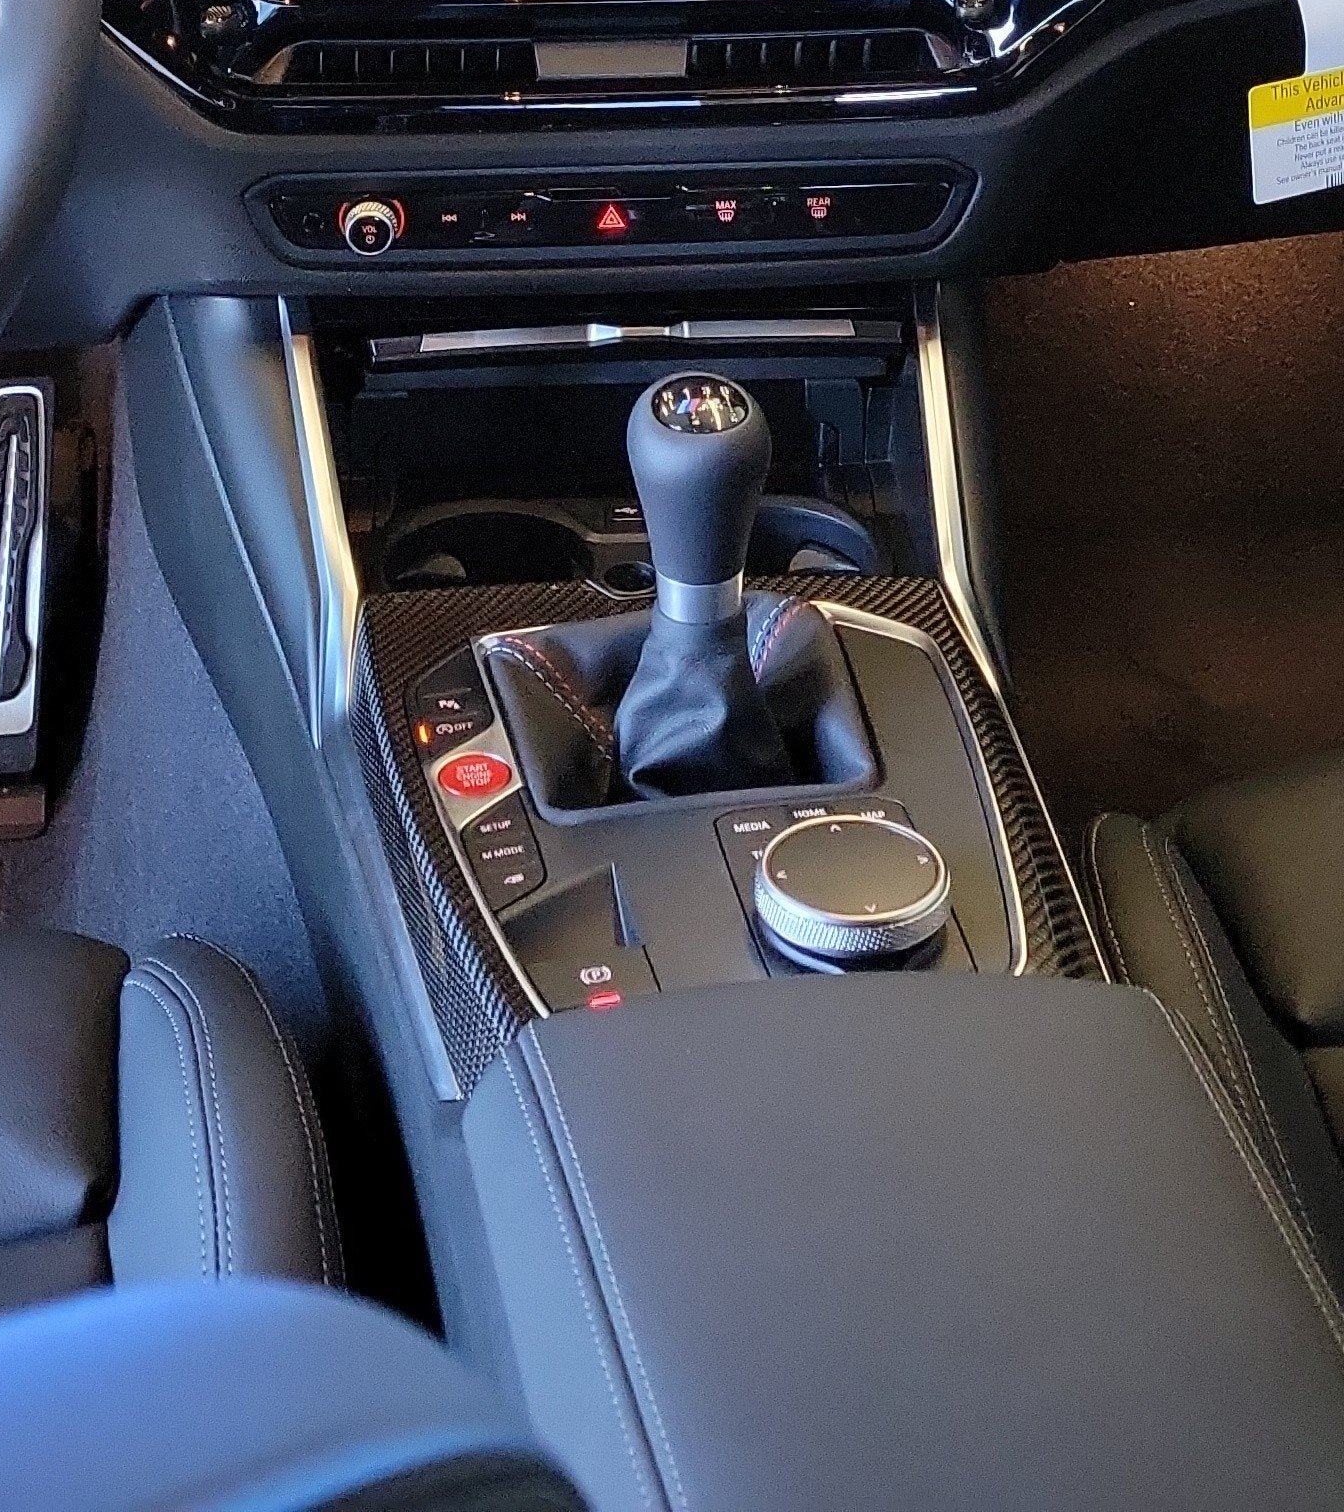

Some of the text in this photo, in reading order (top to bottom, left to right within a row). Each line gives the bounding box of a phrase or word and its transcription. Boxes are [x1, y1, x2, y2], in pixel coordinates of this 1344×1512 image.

[1271, 82, 1300, 101] This
[1294, 118, 1320, 133] Even
[1321, 111, 1344, 127] with
[1276, 134, 1306, 148] Children
[715, 200, 737, 209] MAX
[806, 196, 831, 208] REAR
[361, 225, 377, 234] VOL
[792, 807, 828, 819] HOME
[478, 819, 512, 834] SETUP
[733, 820, 772, 833] MEDIA
